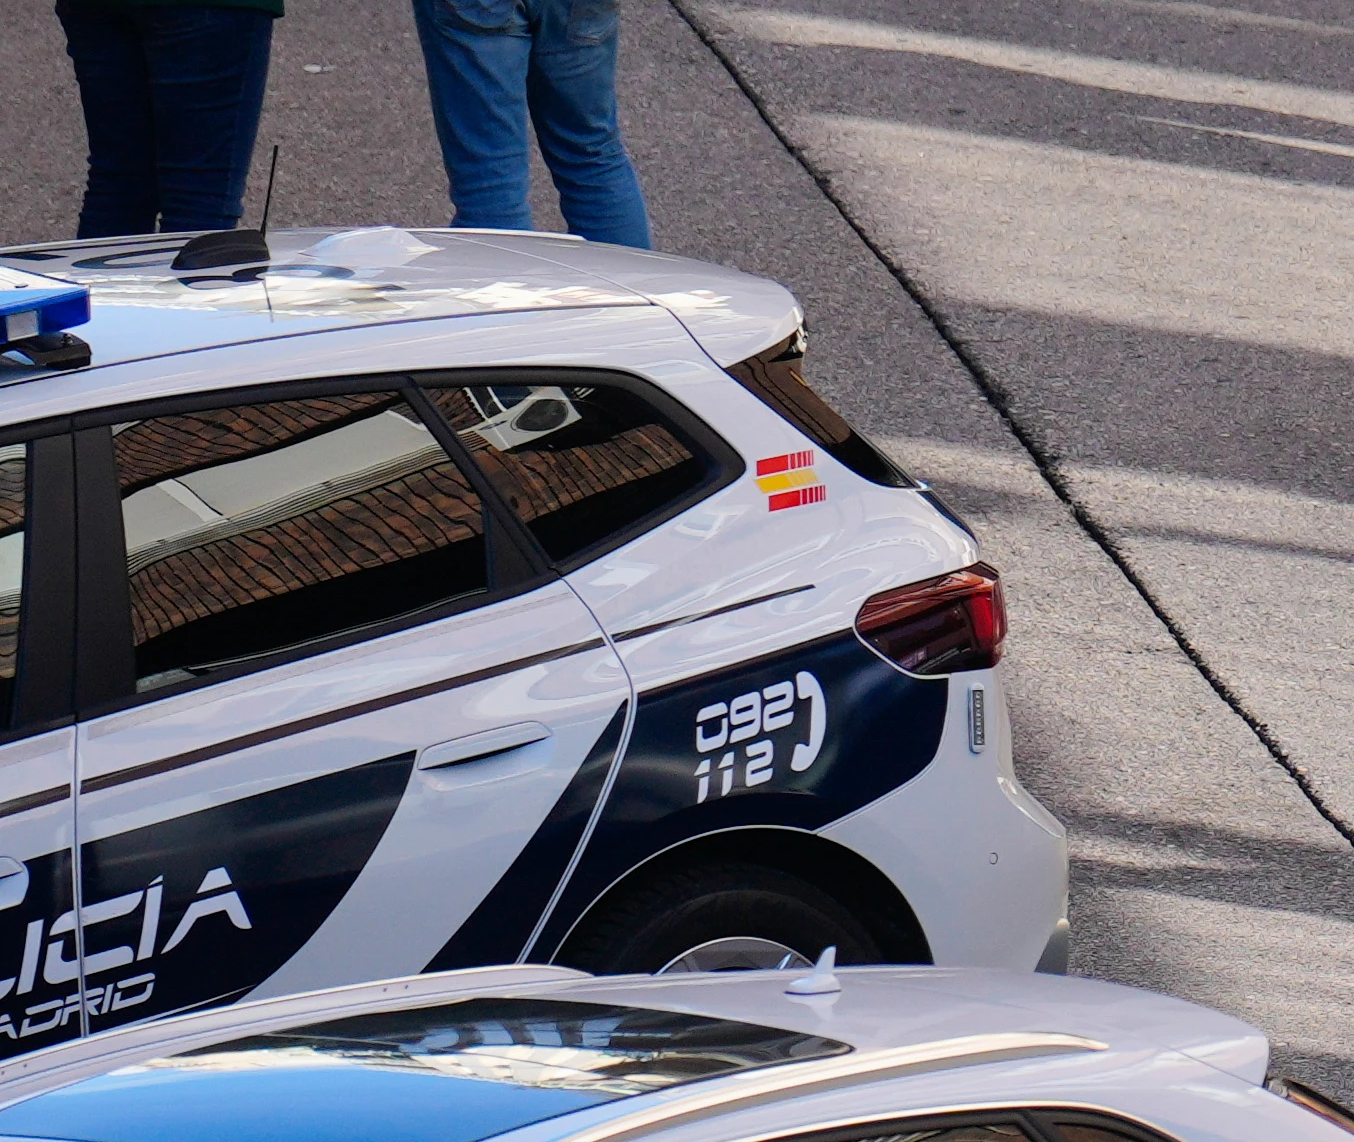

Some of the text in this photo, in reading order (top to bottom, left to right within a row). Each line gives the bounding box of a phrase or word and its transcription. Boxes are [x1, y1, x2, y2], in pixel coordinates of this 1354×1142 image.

[696, 680, 795, 754] 092
[693, 739, 774, 805] 112
[0, 866, 253, 1001] ICÍA
